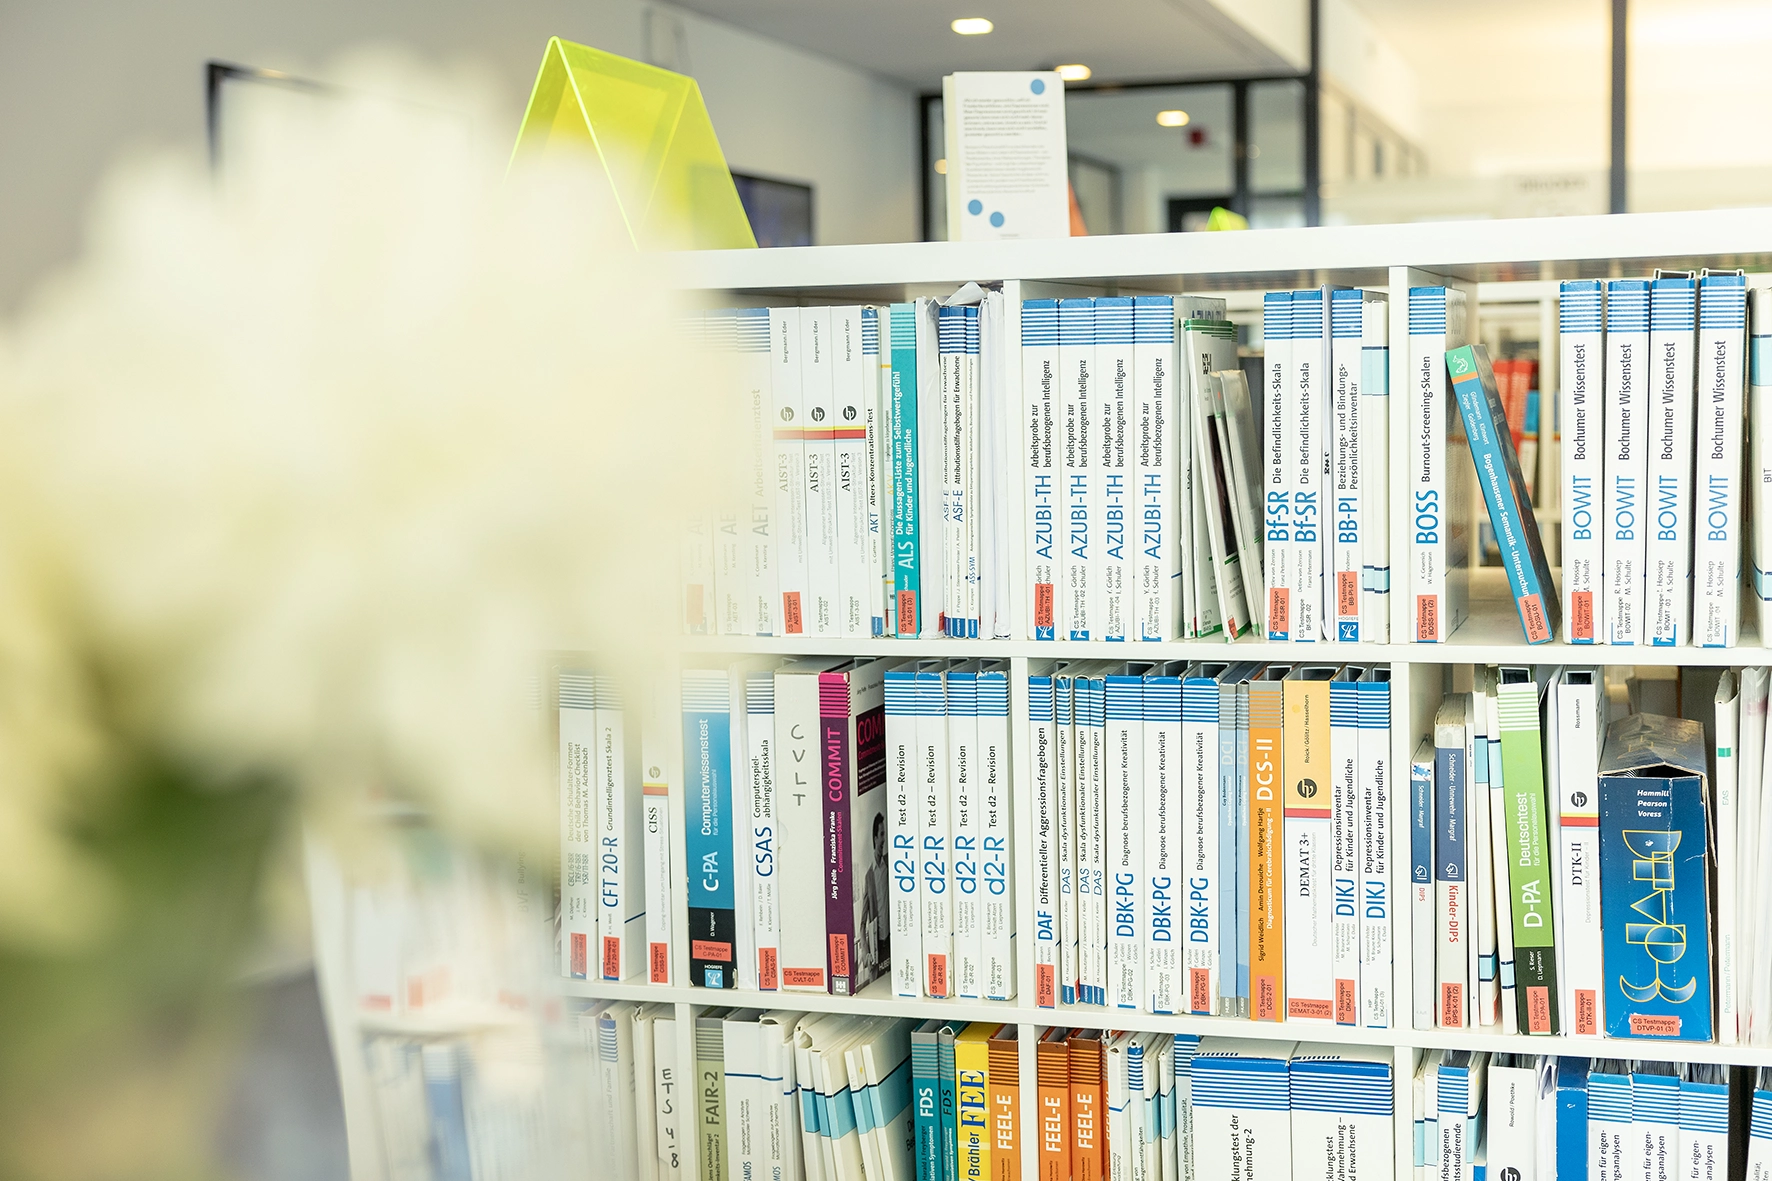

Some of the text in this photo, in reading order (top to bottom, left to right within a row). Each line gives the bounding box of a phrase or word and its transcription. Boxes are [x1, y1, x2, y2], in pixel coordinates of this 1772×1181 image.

[892, 372, 902, 439] Selbstwertgefühl
[953, 356, 962, 484] Attributionsstilfragebogen für Erwachsene
[1041, 361, 1052, 467] berufsbezogenen Intelligenz
[1077, 360, 1088, 467] berufsbezogenen Intelligenz
[1271, 364, 1282, 484] Die Befindlichkeits-Skala
[1299, 363, 1310, 484] Die Befindlichkeits-Skala
[1337, 364, 1348, 489] Beziehungs- und Bindungs-
[903, 429, 913, 476] Jugendliche
[1030, 418, 1040, 467] Arbeitsprobe
[1066, 418, 1076, 467] Arbeitsprobe
[1348, 382, 1359, 489] Persönlichkeitsinventar
[1415, 357, 1438, 544] BOSS Burnout-Screening-Skalen
[1573, 344, 1591, 540] BOWIT Bochumer Wissenstest
[1616, 344, 1634, 540] BOWIT Bochumer Wissenstest
[1658, 343, 1677, 540] BOWIT Bochumer Wissenstest
[778, 454, 788, 492] AIST-3
[809, 454, 819, 492] AIST-3
[841, 453, 851, 491] AIST-3
[867, 409, 879, 533] AKT Alters-Konzentrations-Test
[895, 461, 905, 520] Aussagen-Liste
[905, 496, 913, 521] Kinder
[905, 523, 913, 535] für
[953, 490, 962, 522] ASF-E
[1036, 476, 1052, 559] AZUBI-TH
[1071, 476, 1087, 559] AZUBI-TH
[1107, 475, 1124, 559] AZUBI-TH
[1268, 492, 1289, 541] Bf-SR
[1295, 492, 1316, 542] Bf-SR
[1339, 498, 1358, 543] BB-PI
[1483, 454, 1530, 597] Bogenhausener Semantik Untersuchun
[897, 541, 914, 569] ALS
[1614, 560, 1622, 585] Hossiep
[566, 742, 574, 807] Schulalter-Formen
[760, 740, 772, 818] abhängigkeitsskala
[828, 727, 842, 801] COMMIT
[927, 746, 935, 783] Revision
[1078, 731, 1086, 781] Einstellungen
[1256, 739, 1273, 800] DCS-II
[582, 789, 588, 797] M.
[605, 756, 614, 831] Grundintelligenztest
[700, 719, 719, 891] C-PA Computerwissenstest
[752, 756, 763, 818] Computerspiel-
[928, 796, 935, 807] d2
[1078, 783, 1086, 840] dysfunktionaler
[1638, 810, 1662, 818] Voress
[574, 811, 582, 828] Child
[648, 807, 657, 833] CISS
[894, 745, 915, 893] d2-R Test d2 Revision
[1037, 728, 1053, 940] DAF Differentieller Aggressionsfragebogen
[1116, 730, 1134, 937] DBK-PG Diagnose berufsbezogener Kreativität
[1153, 732, 1171, 942] DBK-PG Diagnose berufsbezogener Kreativität
[1257, 807, 1265, 825] Hartje
[1345, 759, 1354, 871] für Kinder und Jugendliche
[603, 838, 618, 874] 20-R
[755, 827, 773, 877] CSAS
[924, 836, 945, 894] d2-R
[1257, 828, 1266, 857] Wolfgang
[1299, 832, 1310, 897] DEMAT 3+
[1334, 786, 1354, 916] DIKJ Depressionsinventar
[1364, 788, 1385, 918] DIKJ Depressionsinventar
[1516, 793, 1543, 927] D-PA Deutschtest
[1571, 842, 1582, 886] DTK-II
[603, 879, 618, 907] CFT
[1080, 868, 1089, 893] DAS
[1094, 870, 1102, 895] DAS
[1266, 879, 1274, 887] für
[1266, 890, 1274, 929] Diagnosticum
[1448, 885, 1458, 942] Kinder-DIPS
[1644, 1018, 1676, 1026] Testmappe
[704, 1072, 720, 1125] FAIR-2
[919, 1088, 933, 1117] FDS
[942, 1089, 952, 1115] FDS
[960, 1070, 985, 1176] Brähler FEE
[997, 1095, 1013, 1149] FEEL-E
[1045, 1097, 1061, 1152] FEEL-E
[1077, 1094, 1092, 1148] FEEL-E
[1230, 1114, 1239, 1130] der
[1348, 1124, 1356, 1173] Erwachsene
[1644, 1131, 1653, 1169] für eigen-
